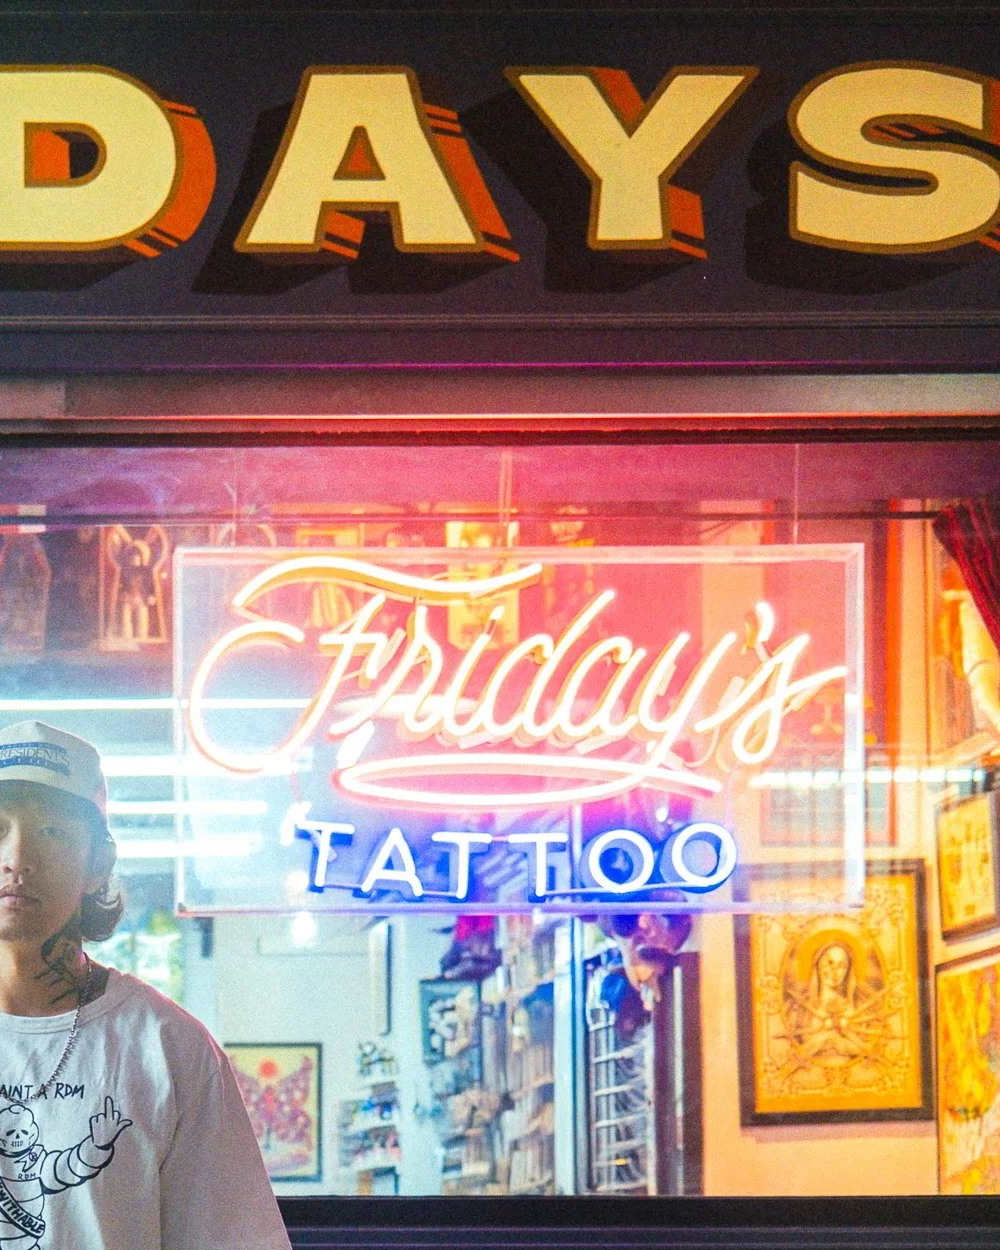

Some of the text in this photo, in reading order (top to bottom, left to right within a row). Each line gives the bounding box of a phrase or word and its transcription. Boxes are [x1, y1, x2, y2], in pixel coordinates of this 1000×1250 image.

[188, 555, 848, 806] Friday's
[281, 821, 738, 900] TATTOO
[0, 1083, 33, 1099] AINT
[37, 1083, 48, 1099] A
[55, 1082, 85, 1099] RDM
